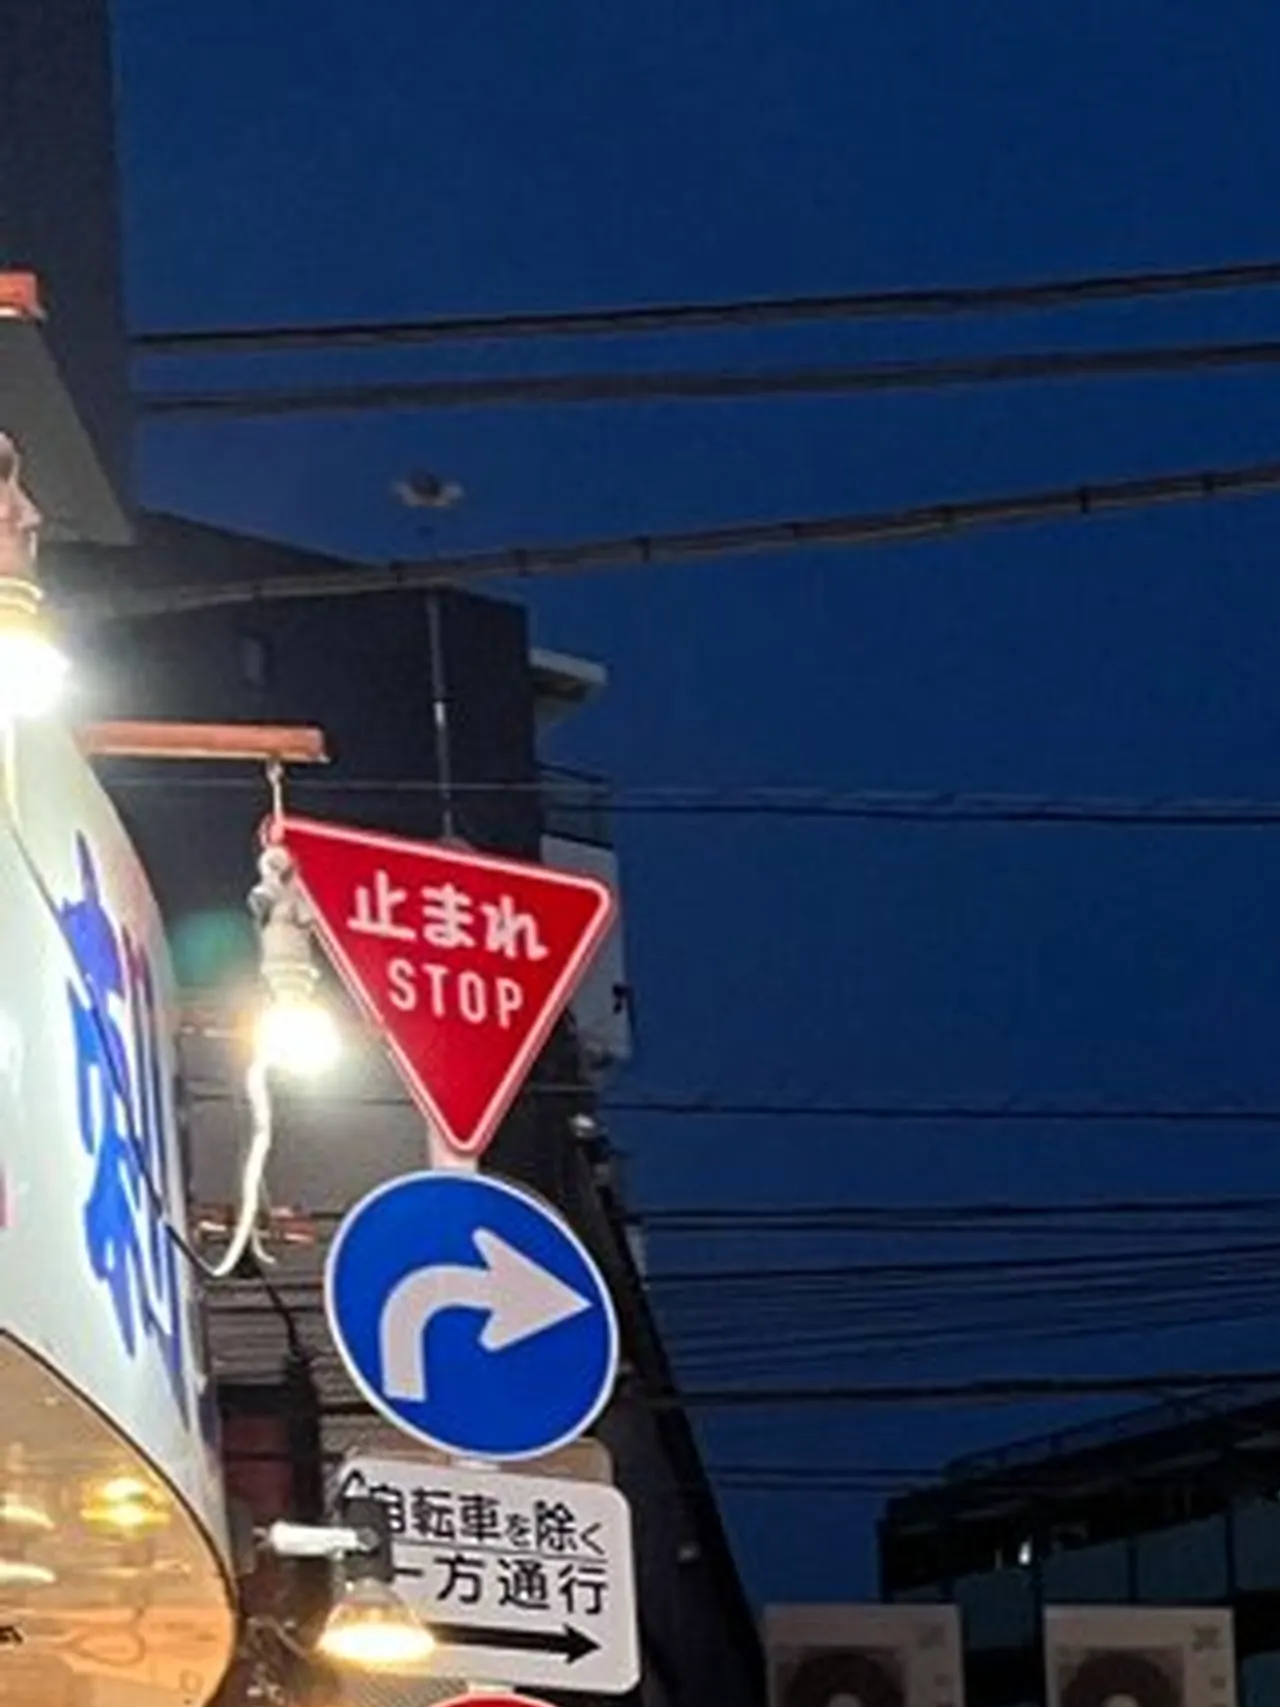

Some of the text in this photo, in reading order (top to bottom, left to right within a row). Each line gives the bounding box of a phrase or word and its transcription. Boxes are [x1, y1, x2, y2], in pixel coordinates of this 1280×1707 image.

[346, 869, 550, 960] 止まれ
[387, 958, 525, 1030] STOP
[393, 1554, 609, 1616] 一方通行
